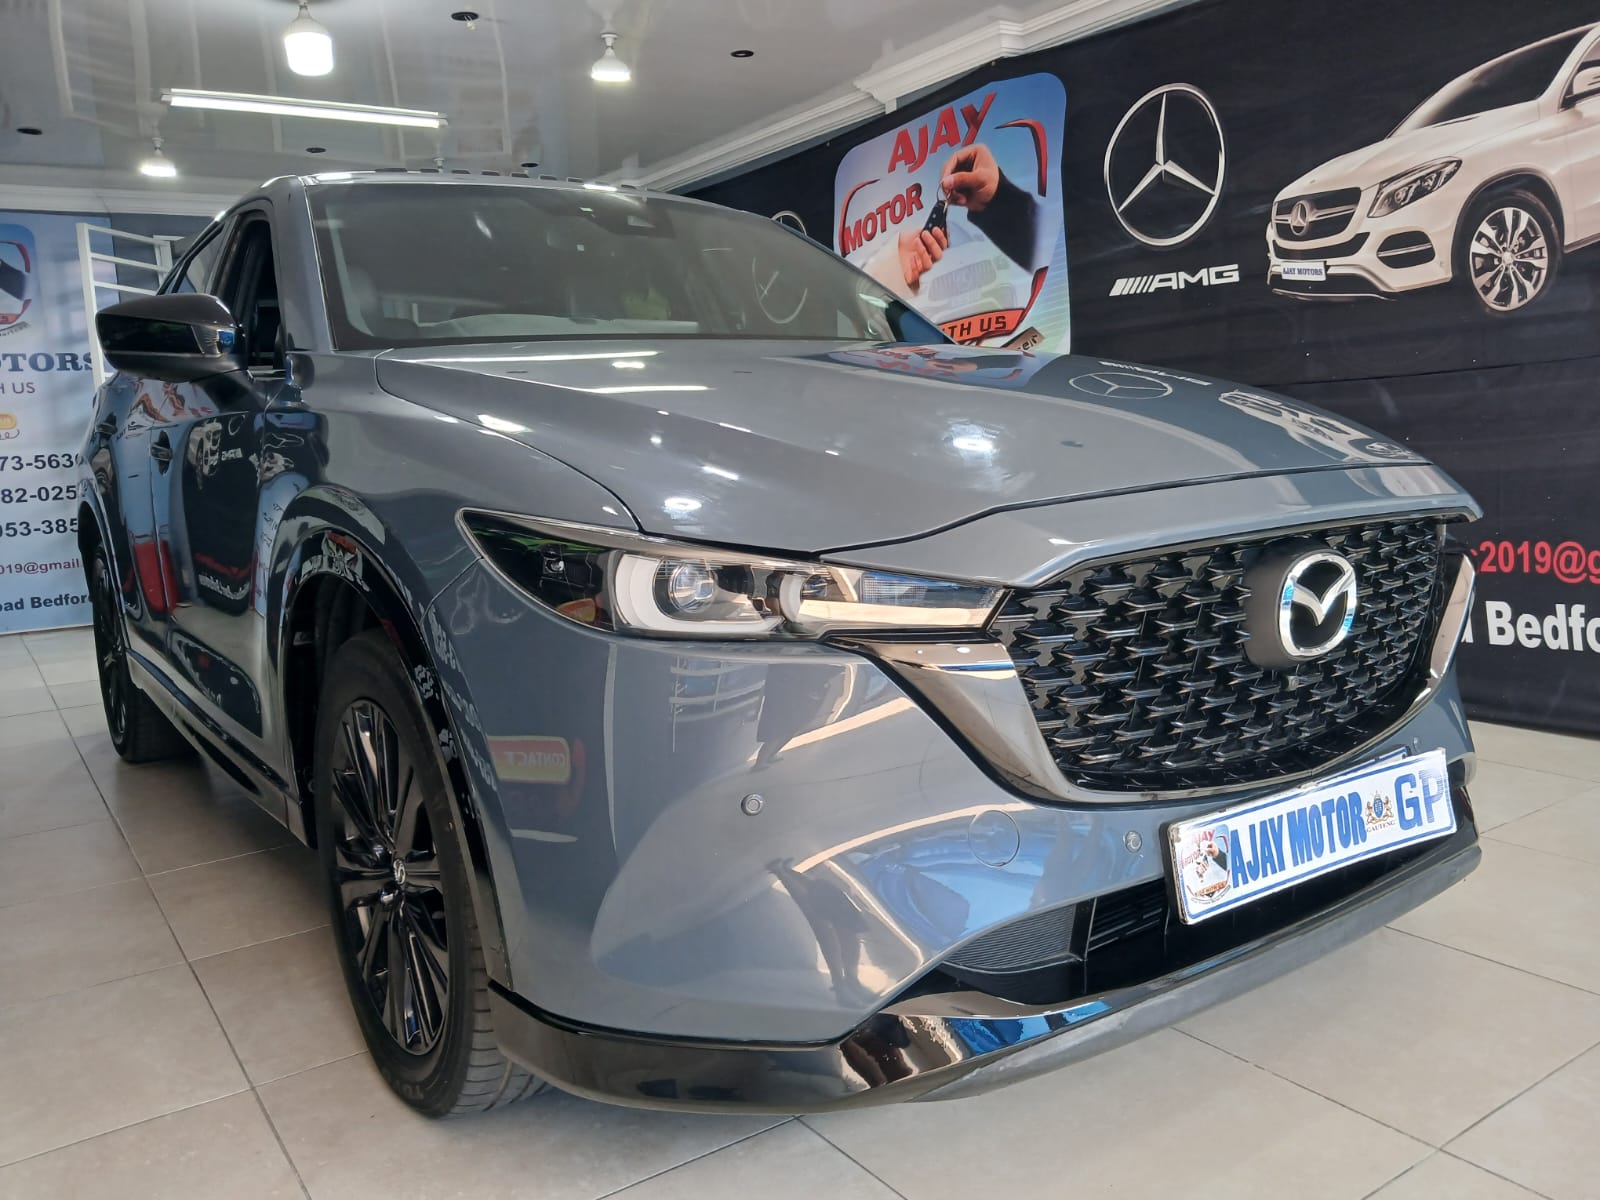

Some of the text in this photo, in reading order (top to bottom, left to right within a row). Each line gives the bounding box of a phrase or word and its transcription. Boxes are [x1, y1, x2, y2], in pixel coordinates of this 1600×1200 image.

[887, 92, 997, 174] AJAY
[843, 182, 924, 256] MOTOR
[1148, 263, 1241, 293] AMG
[1297, 267, 1324, 276] MOTORS
[980, 315, 1007, 332] US
[12, 381, 36, 394] US
[0, 518, 79, 538] 53-385
[1230, 769, 1445, 888] AJAY MOTOR GP
